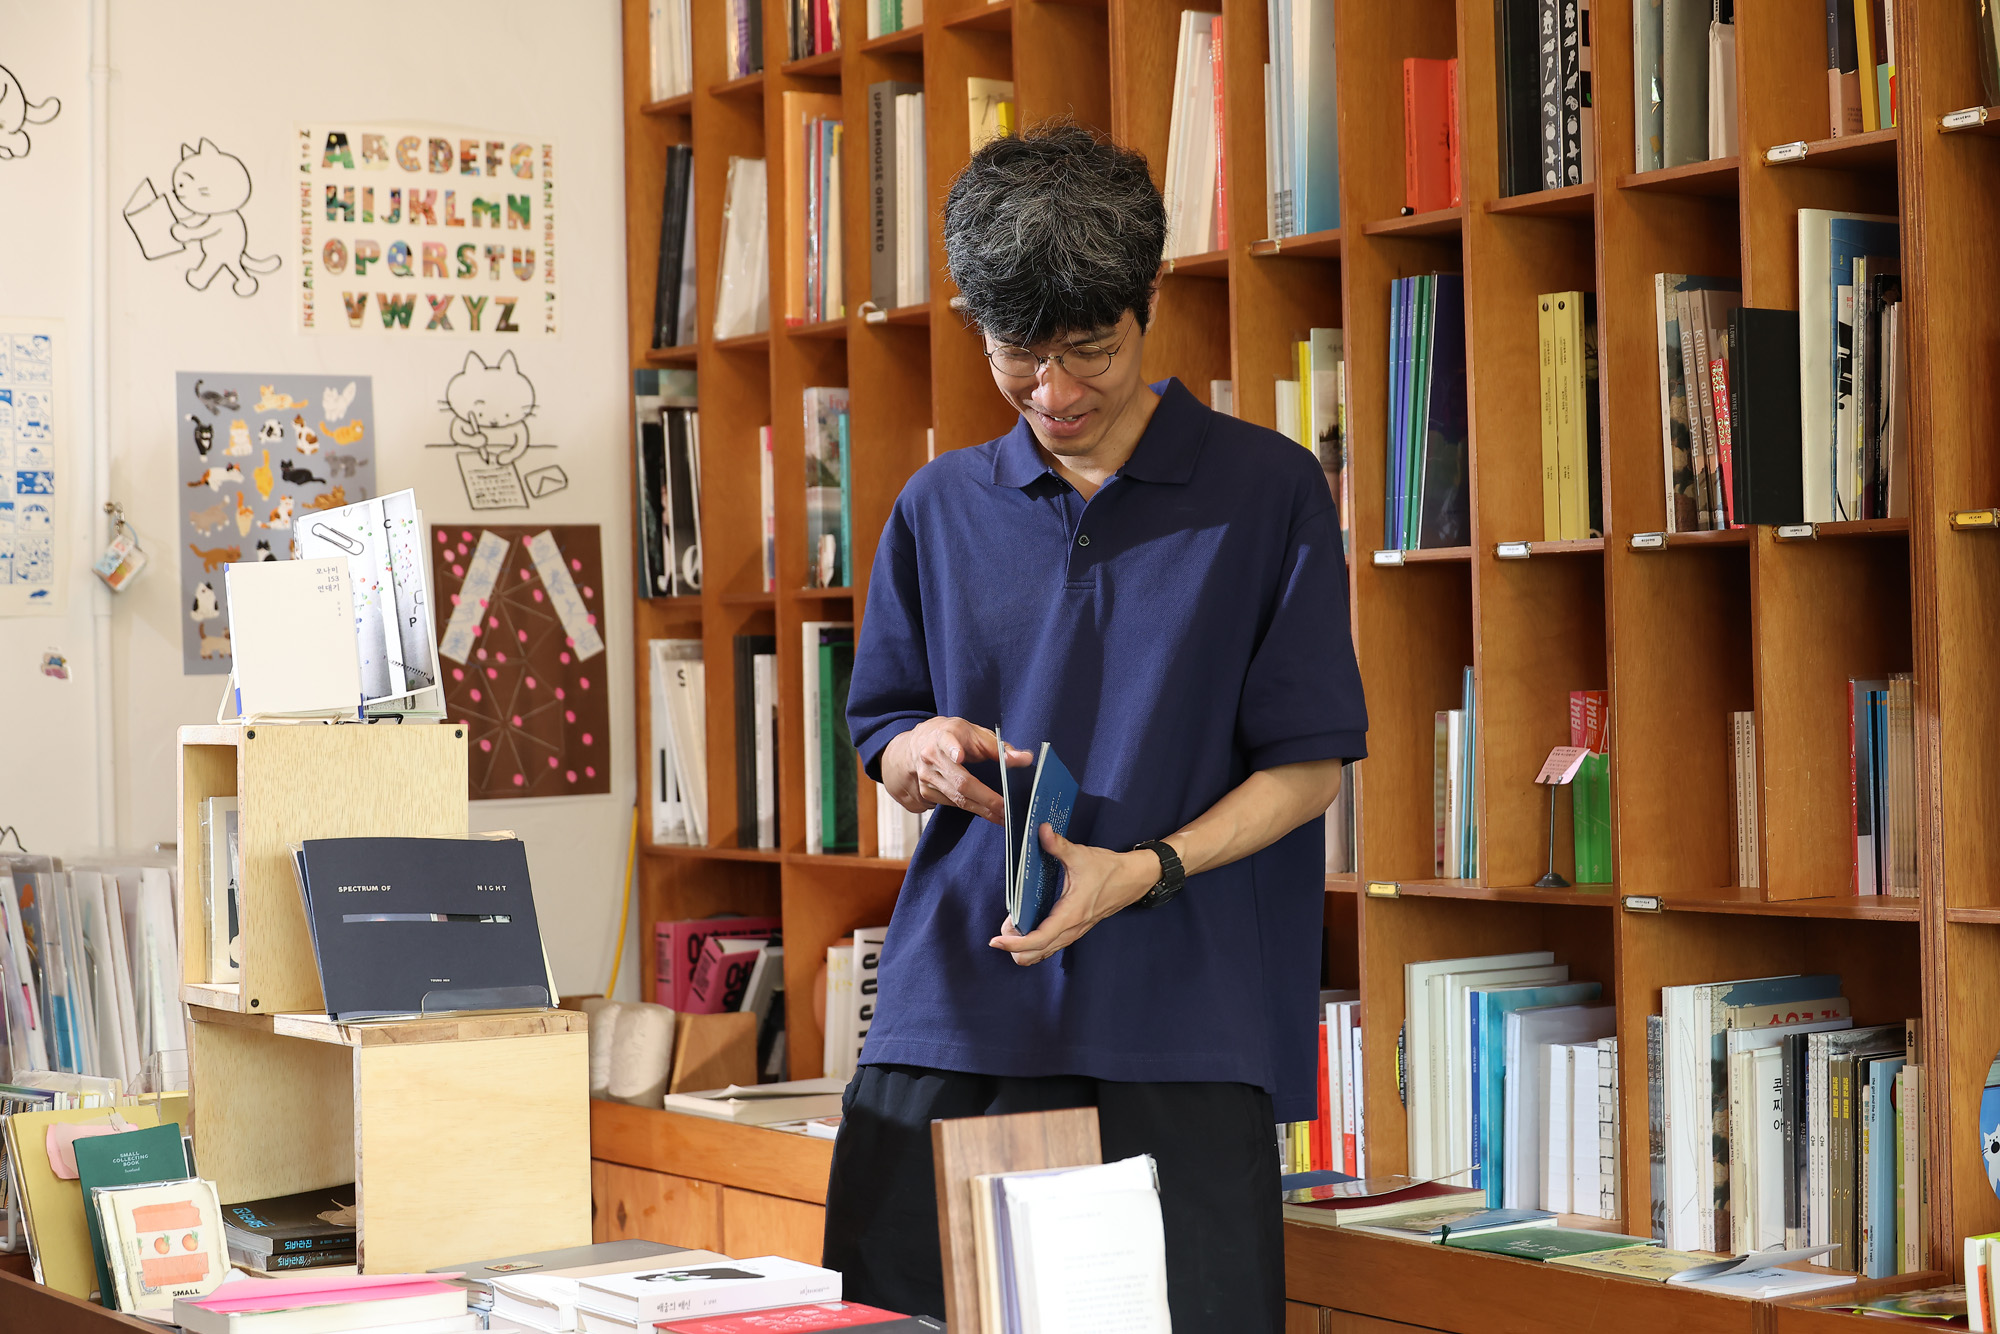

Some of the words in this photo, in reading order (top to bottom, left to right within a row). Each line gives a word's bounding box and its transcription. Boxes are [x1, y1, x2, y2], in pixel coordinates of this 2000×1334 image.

[1681, 330, 1691, 376] Killing
[1694, 329, 1705, 374] Killing
[1686, 383, 1695, 409] and
[1700, 382, 1709, 407] and
[1689, 416, 1699, 457] Dying
[1703, 415, 1713, 456] Dying
[316, 566, 339, 575] 모나미
[317, 583, 340, 593] 연대기
[338, 885, 379, 893] SPECTRUM
[476, 884, 507, 892] NIGHT
[112, 1154, 149, 1164] COLLECTING
[284, 1239, 313, 1250] 되바라진
[172, 1289, 200, 1297] SMALL
